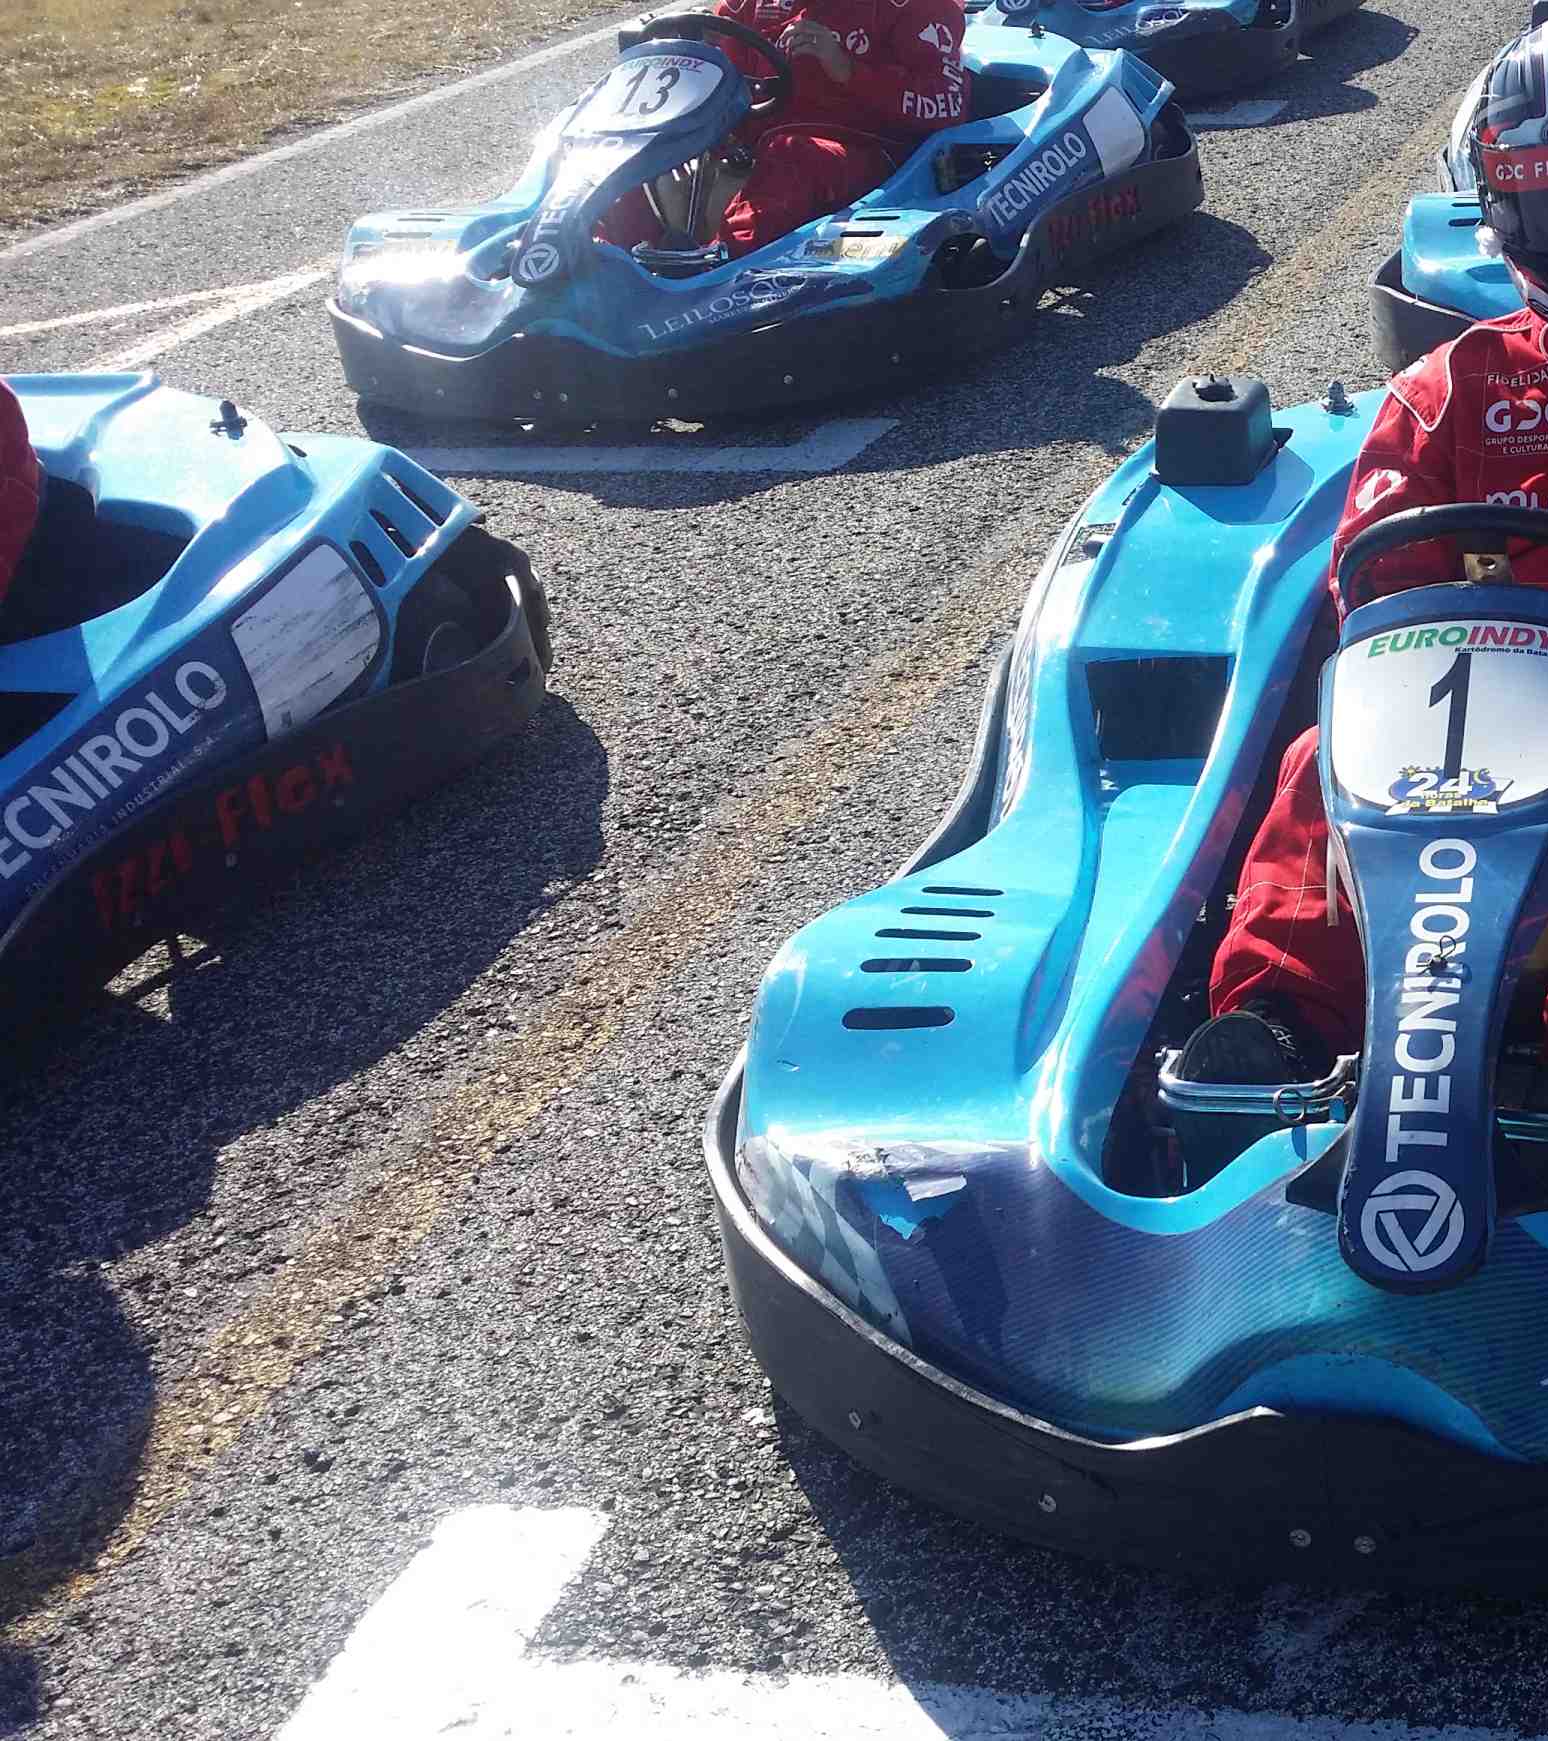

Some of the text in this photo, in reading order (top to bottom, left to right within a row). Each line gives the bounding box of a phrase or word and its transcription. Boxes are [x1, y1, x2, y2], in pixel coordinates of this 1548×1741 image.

[617, 64, 681, 115] 13
[988, 131, 1088, 226] TECNIROLO
[1485, 437, 1516, 446] GRUPO
[1429, 652, 1473, 779] 1
[1406, 771, 1473, 798] 24
[1385, 838, 1478, 1163] TECNIROLO
